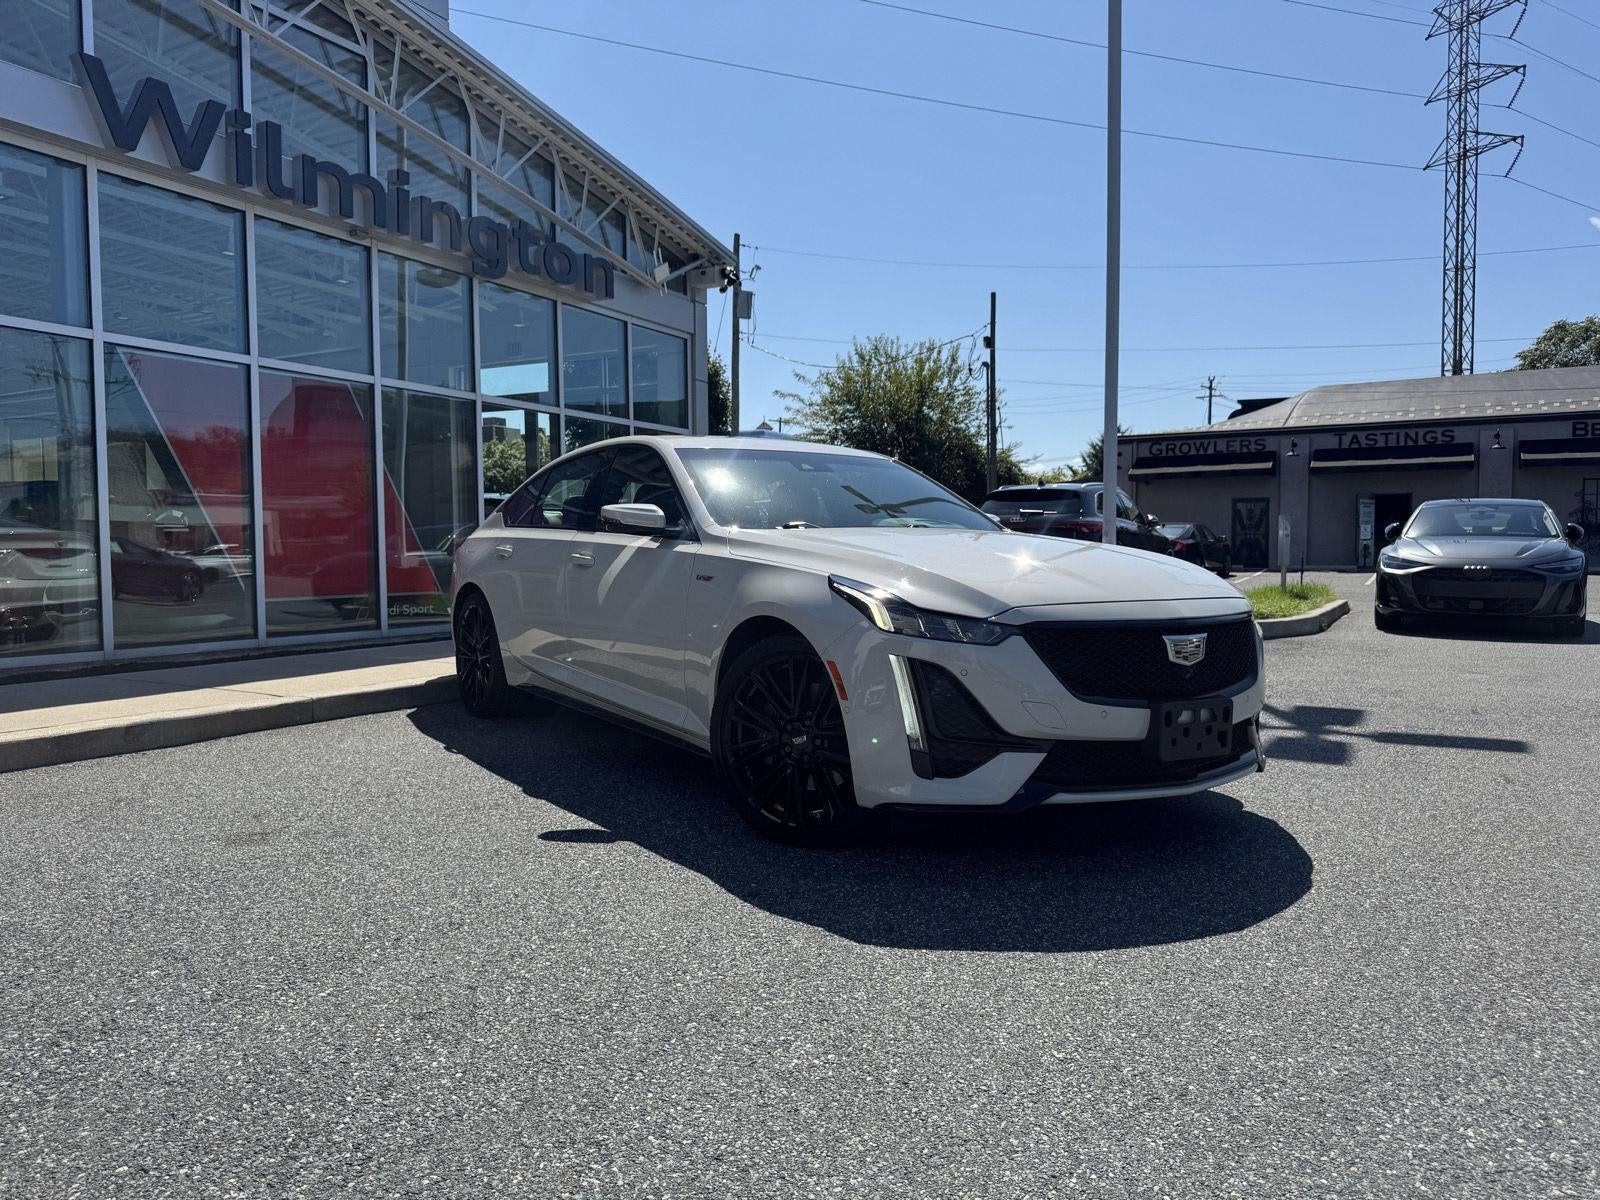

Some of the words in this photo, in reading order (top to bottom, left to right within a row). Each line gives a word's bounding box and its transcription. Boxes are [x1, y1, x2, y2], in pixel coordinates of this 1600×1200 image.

[70, 51, 614, 299] Wilmington
[1148, 438, 1267, 456] GROWLERS
[1333, 429, 1456, 449] TASTINGS
[402, 603, 434, 616] Sport
